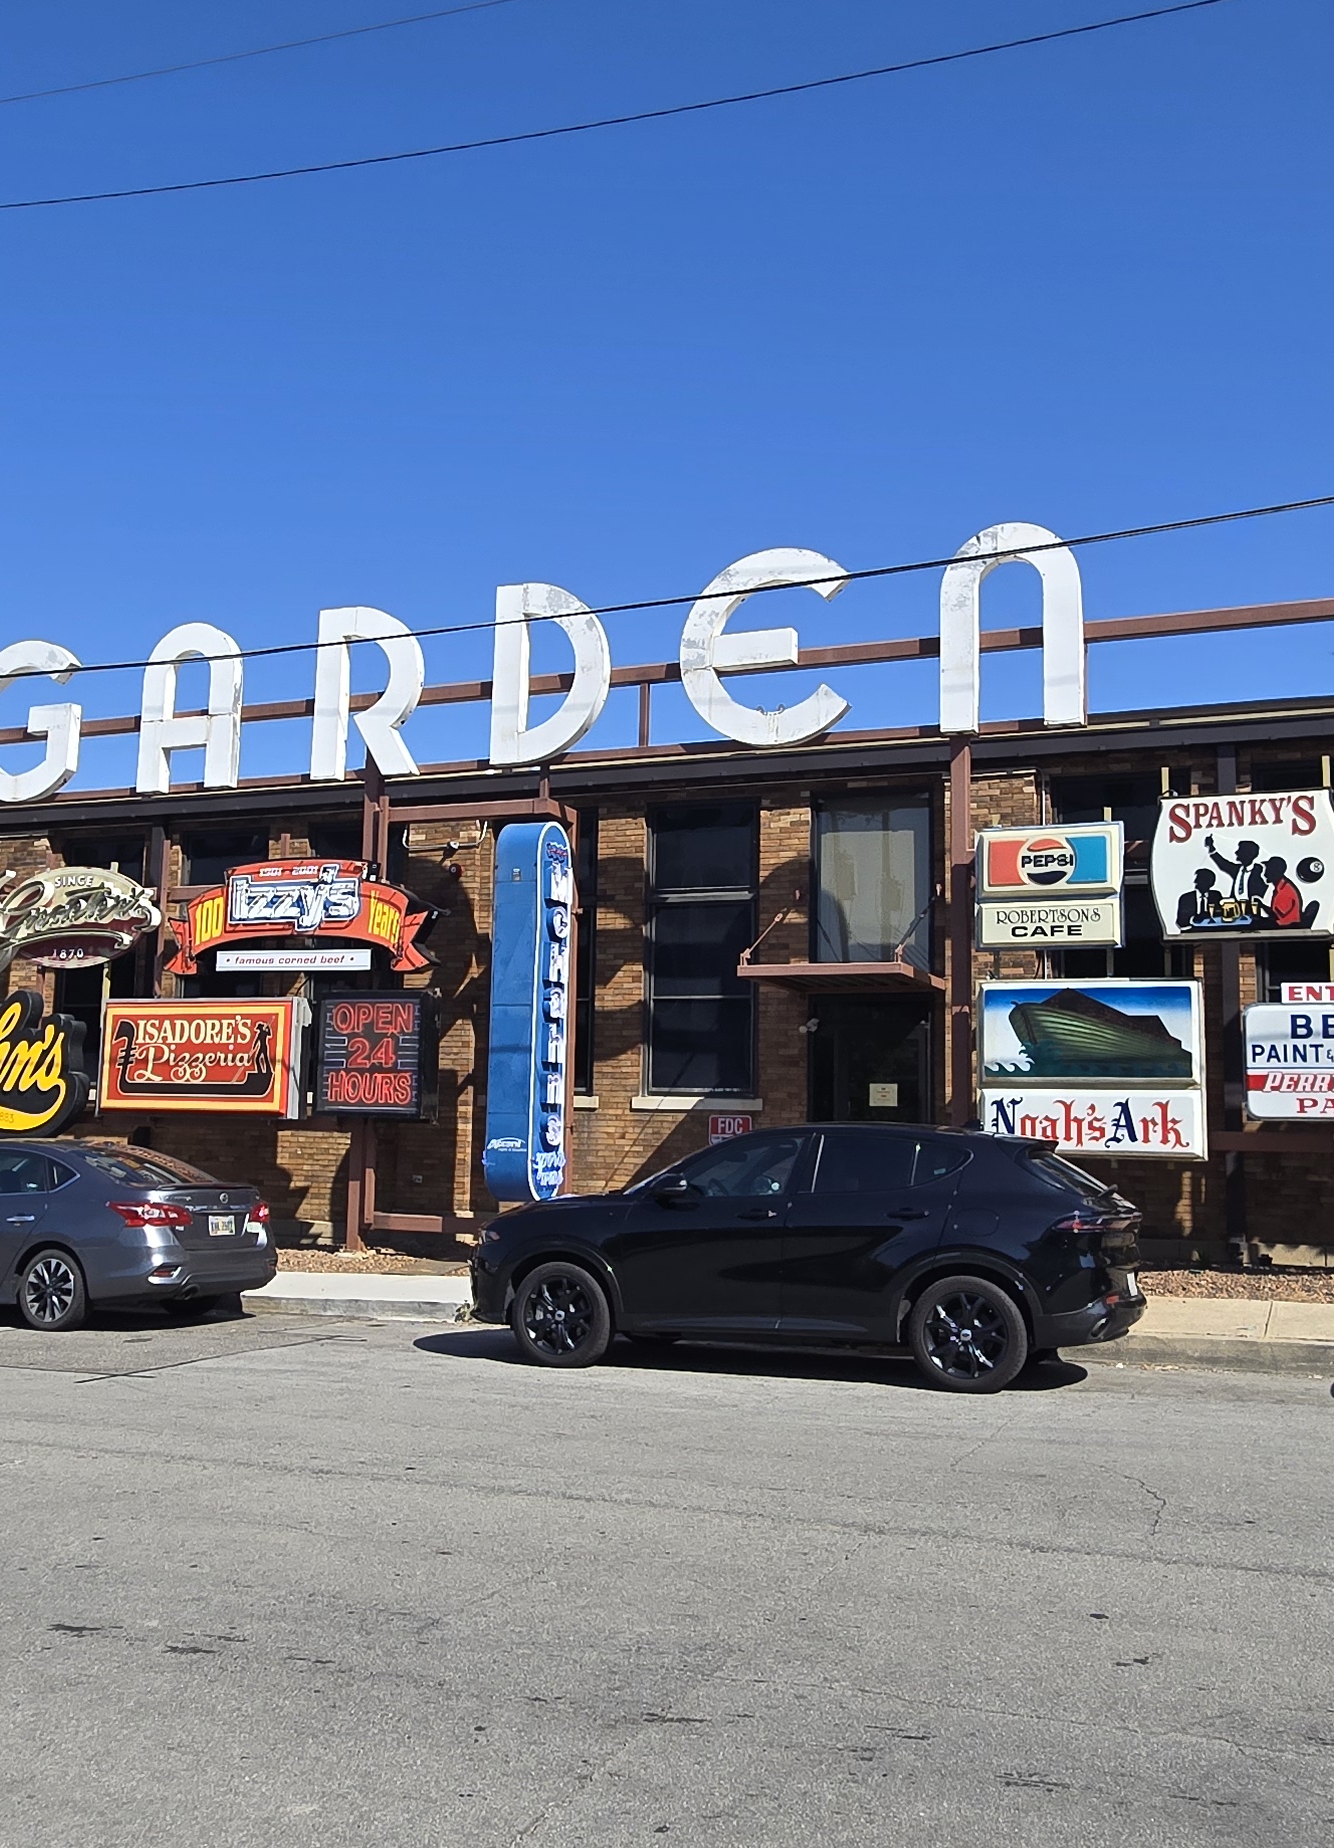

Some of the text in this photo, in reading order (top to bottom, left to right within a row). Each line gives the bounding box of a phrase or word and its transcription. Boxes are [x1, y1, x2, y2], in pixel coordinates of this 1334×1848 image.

[1168, 795, 1317, 844] SPANKY'S
[1021, 853, 1074, 868] PEPSI
[54, 875, 94, 887] SINCE
[195, 890, 400, 946] 100 Years
[996, 907, 1101, 924] ROBERTSONS
[1011, 924, 1083, 938] CAFE
[53, 948, 84, 960] 1870
[234, 954, 345, 965] famous corned beef
[135, 1015, 252, 1044] ISADORE'S
[332, 1003, 413, 1034] OPEN
[133, 1043, 253, 1082] Pizzeria
[347, 1037, 396, 1068] 24
[1251, 1043, 1324, 1064] PAINT
[328, 1071, 413, 1105] HOURS
[718, 1117, 743, 1134] FDC
[990, 1096, 1190, 1149] Noah's Ark
